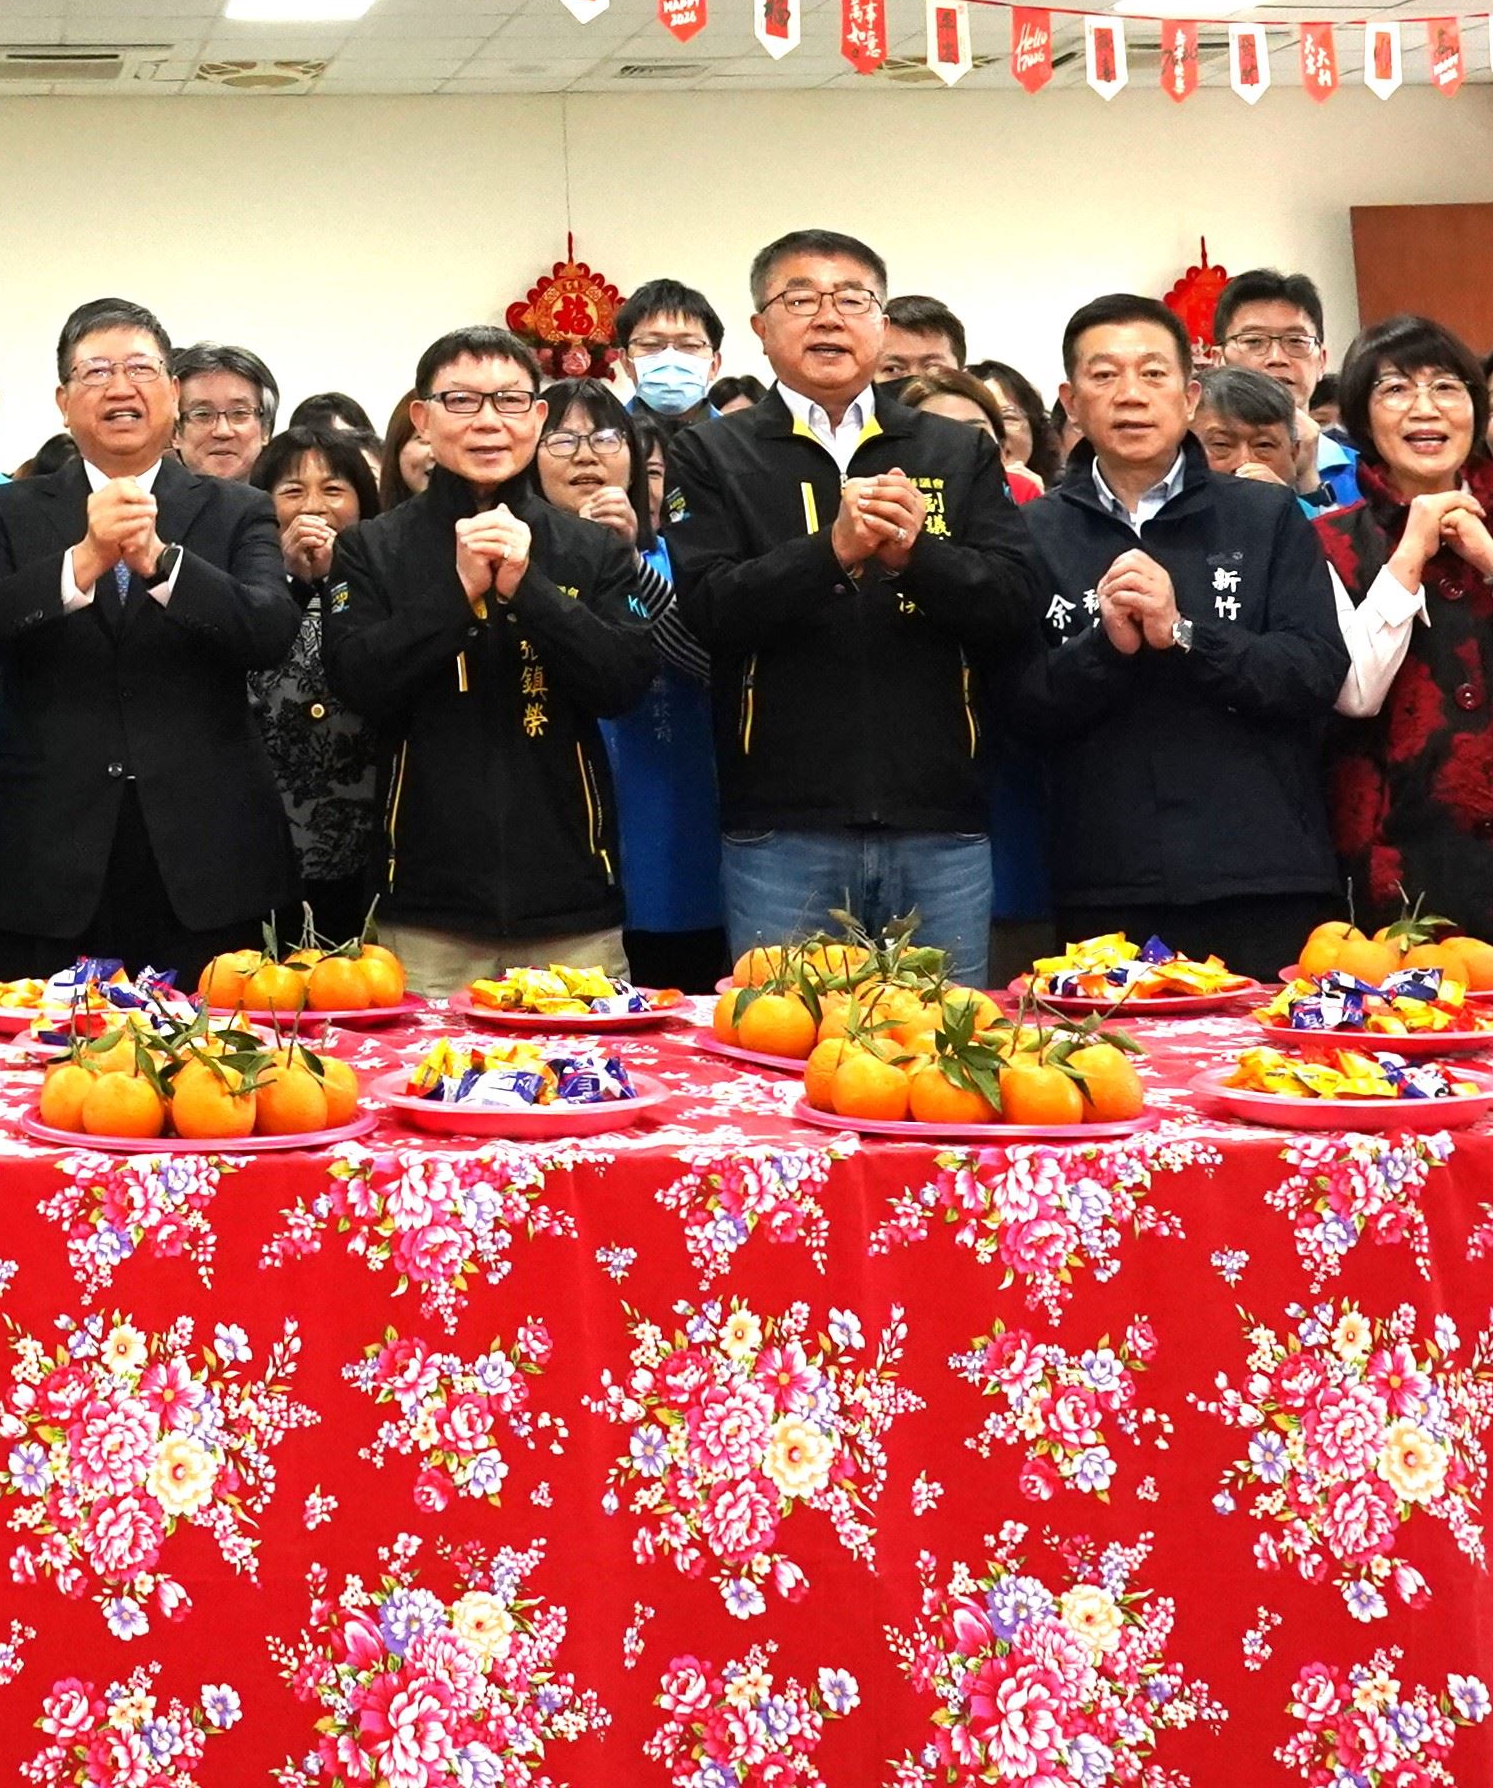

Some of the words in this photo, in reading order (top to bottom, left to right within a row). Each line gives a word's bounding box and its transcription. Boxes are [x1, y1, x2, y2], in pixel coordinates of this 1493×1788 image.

[670, 12, 696, 26] 2026
[553, 294, 593, 335] 福
[1212, 567, 1242, 621] 新竹
